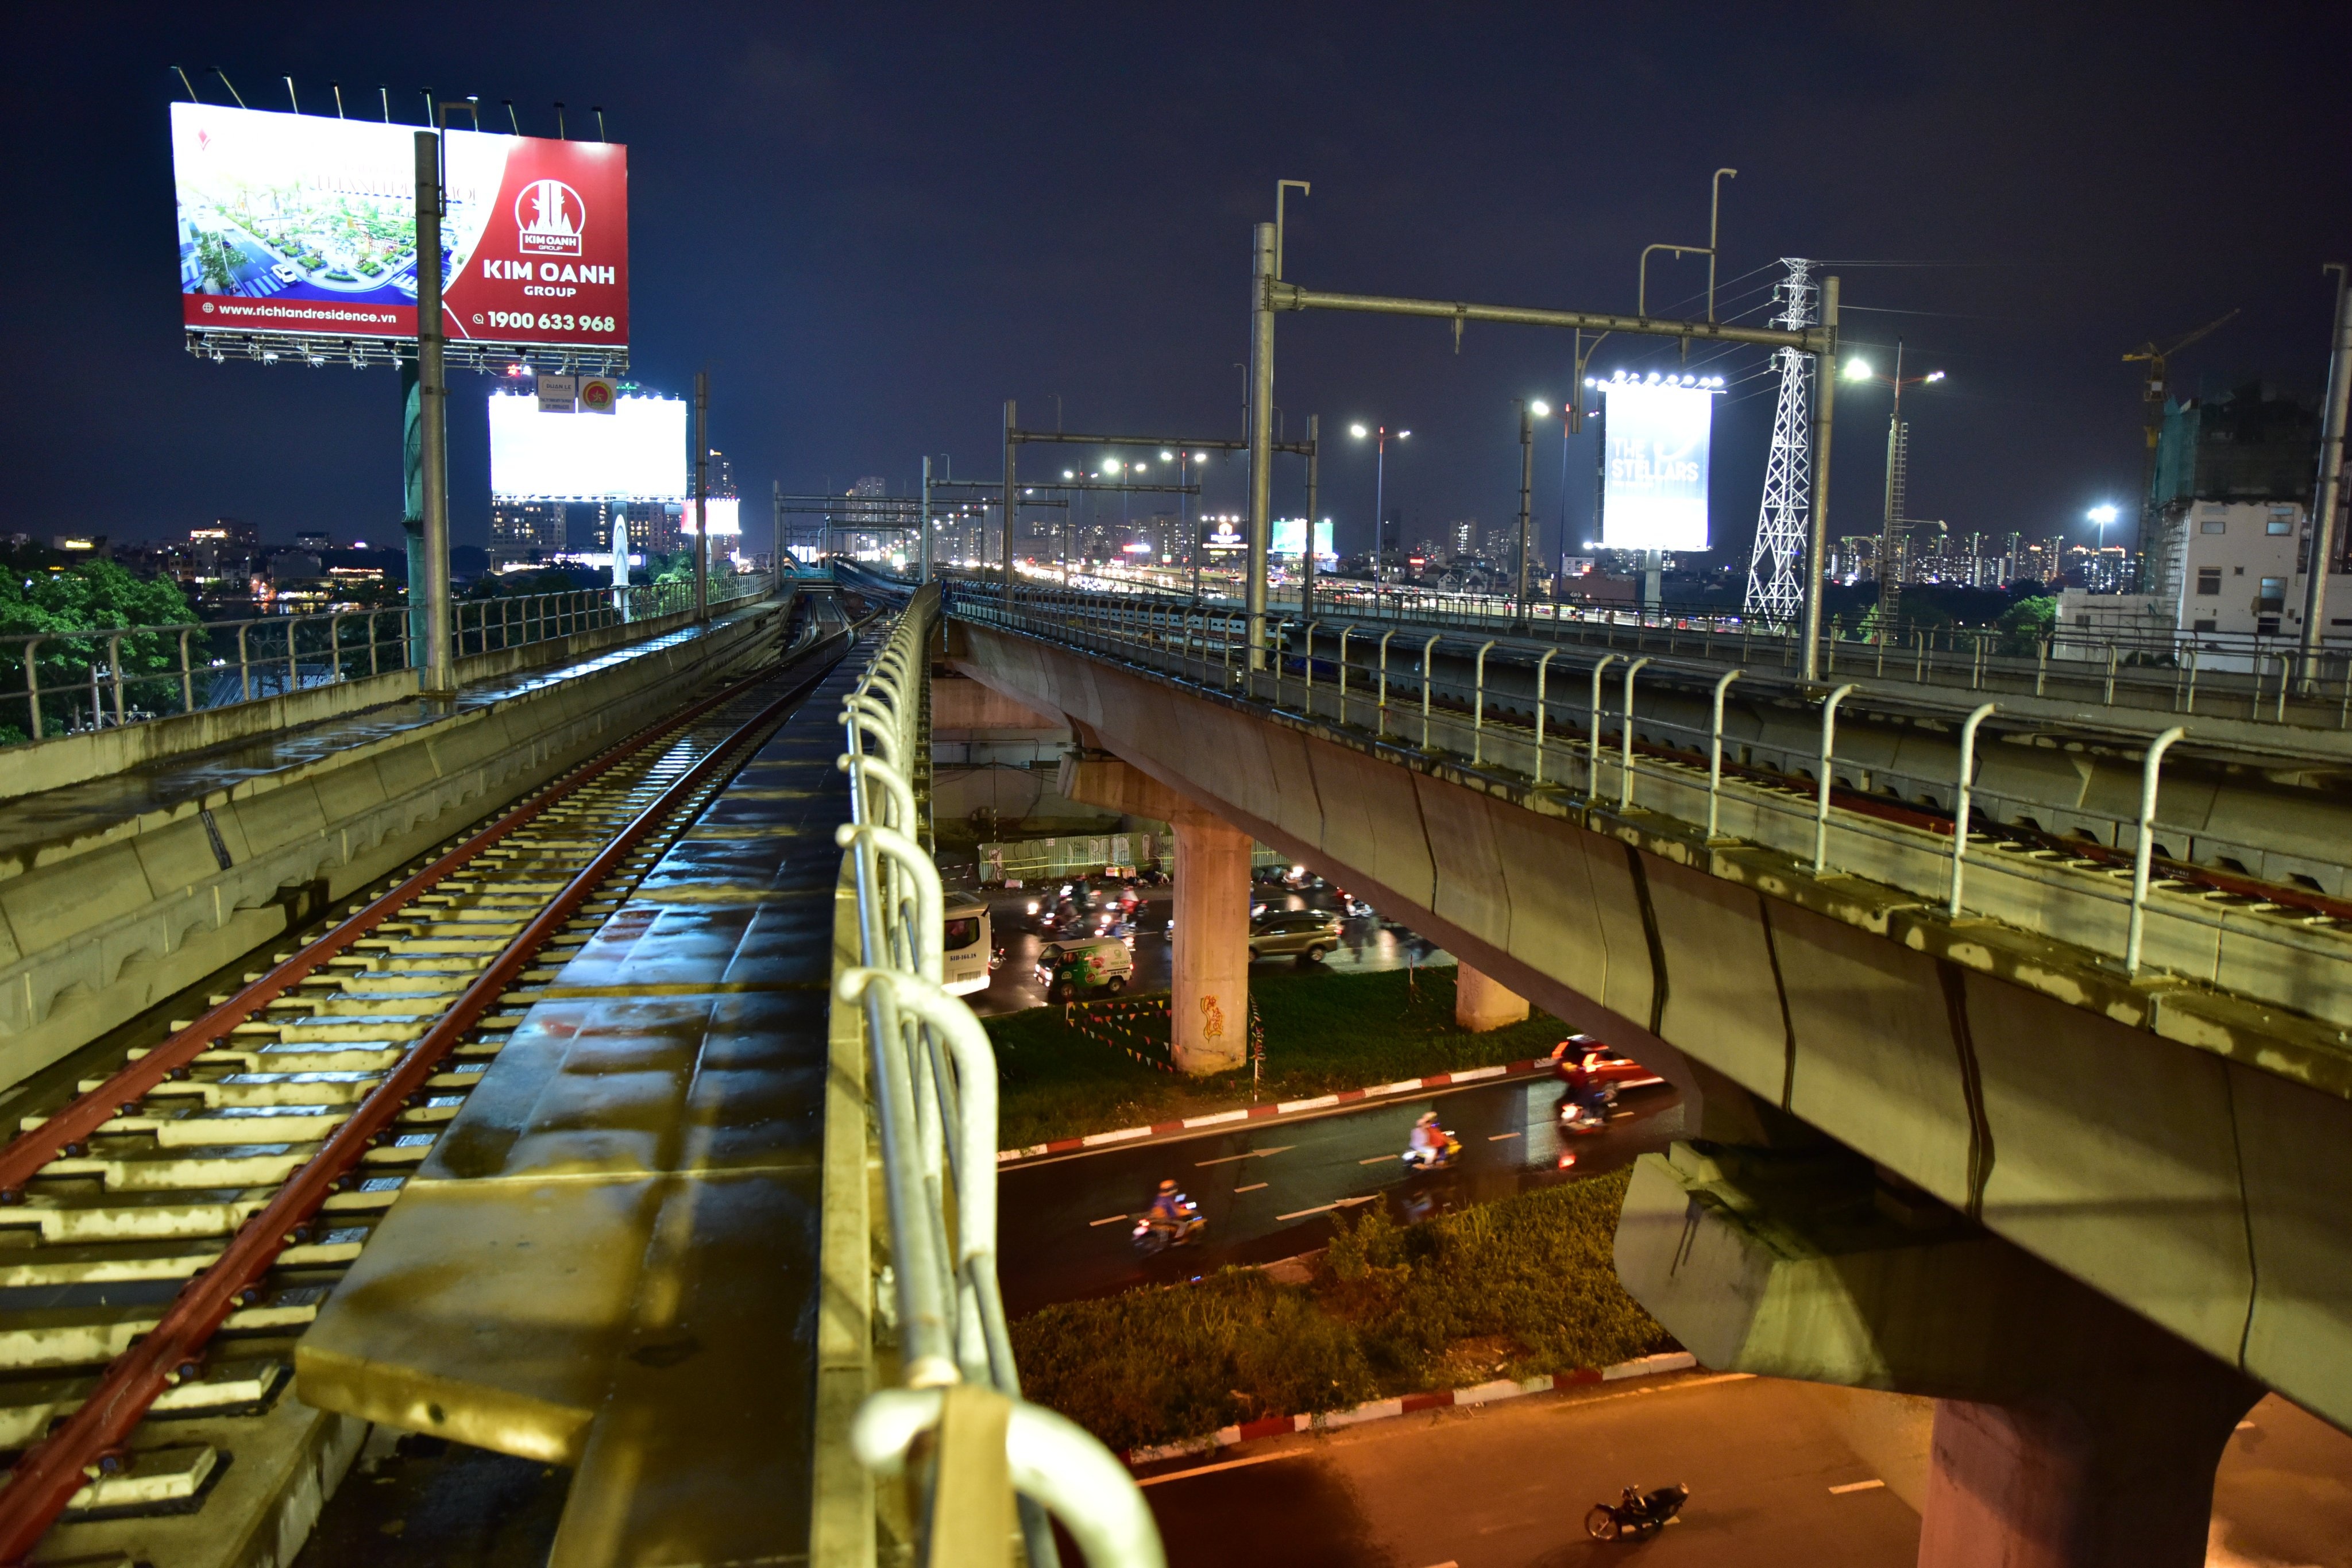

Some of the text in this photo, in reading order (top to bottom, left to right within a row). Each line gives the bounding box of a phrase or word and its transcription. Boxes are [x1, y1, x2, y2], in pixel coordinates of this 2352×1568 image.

[525, 235, 577, 246] KIM OANH
[484, 259, 615, 284] KIM OANH
[524, 285, 577, 297] GROUP
[219, 304, 397, 323] www.richlandresidence.vn
[488, 311, 615, 332] 1900 633 968
[1612, 437, 1646, 459] THE
[1611, 458, 1699, 482] STELLARS
